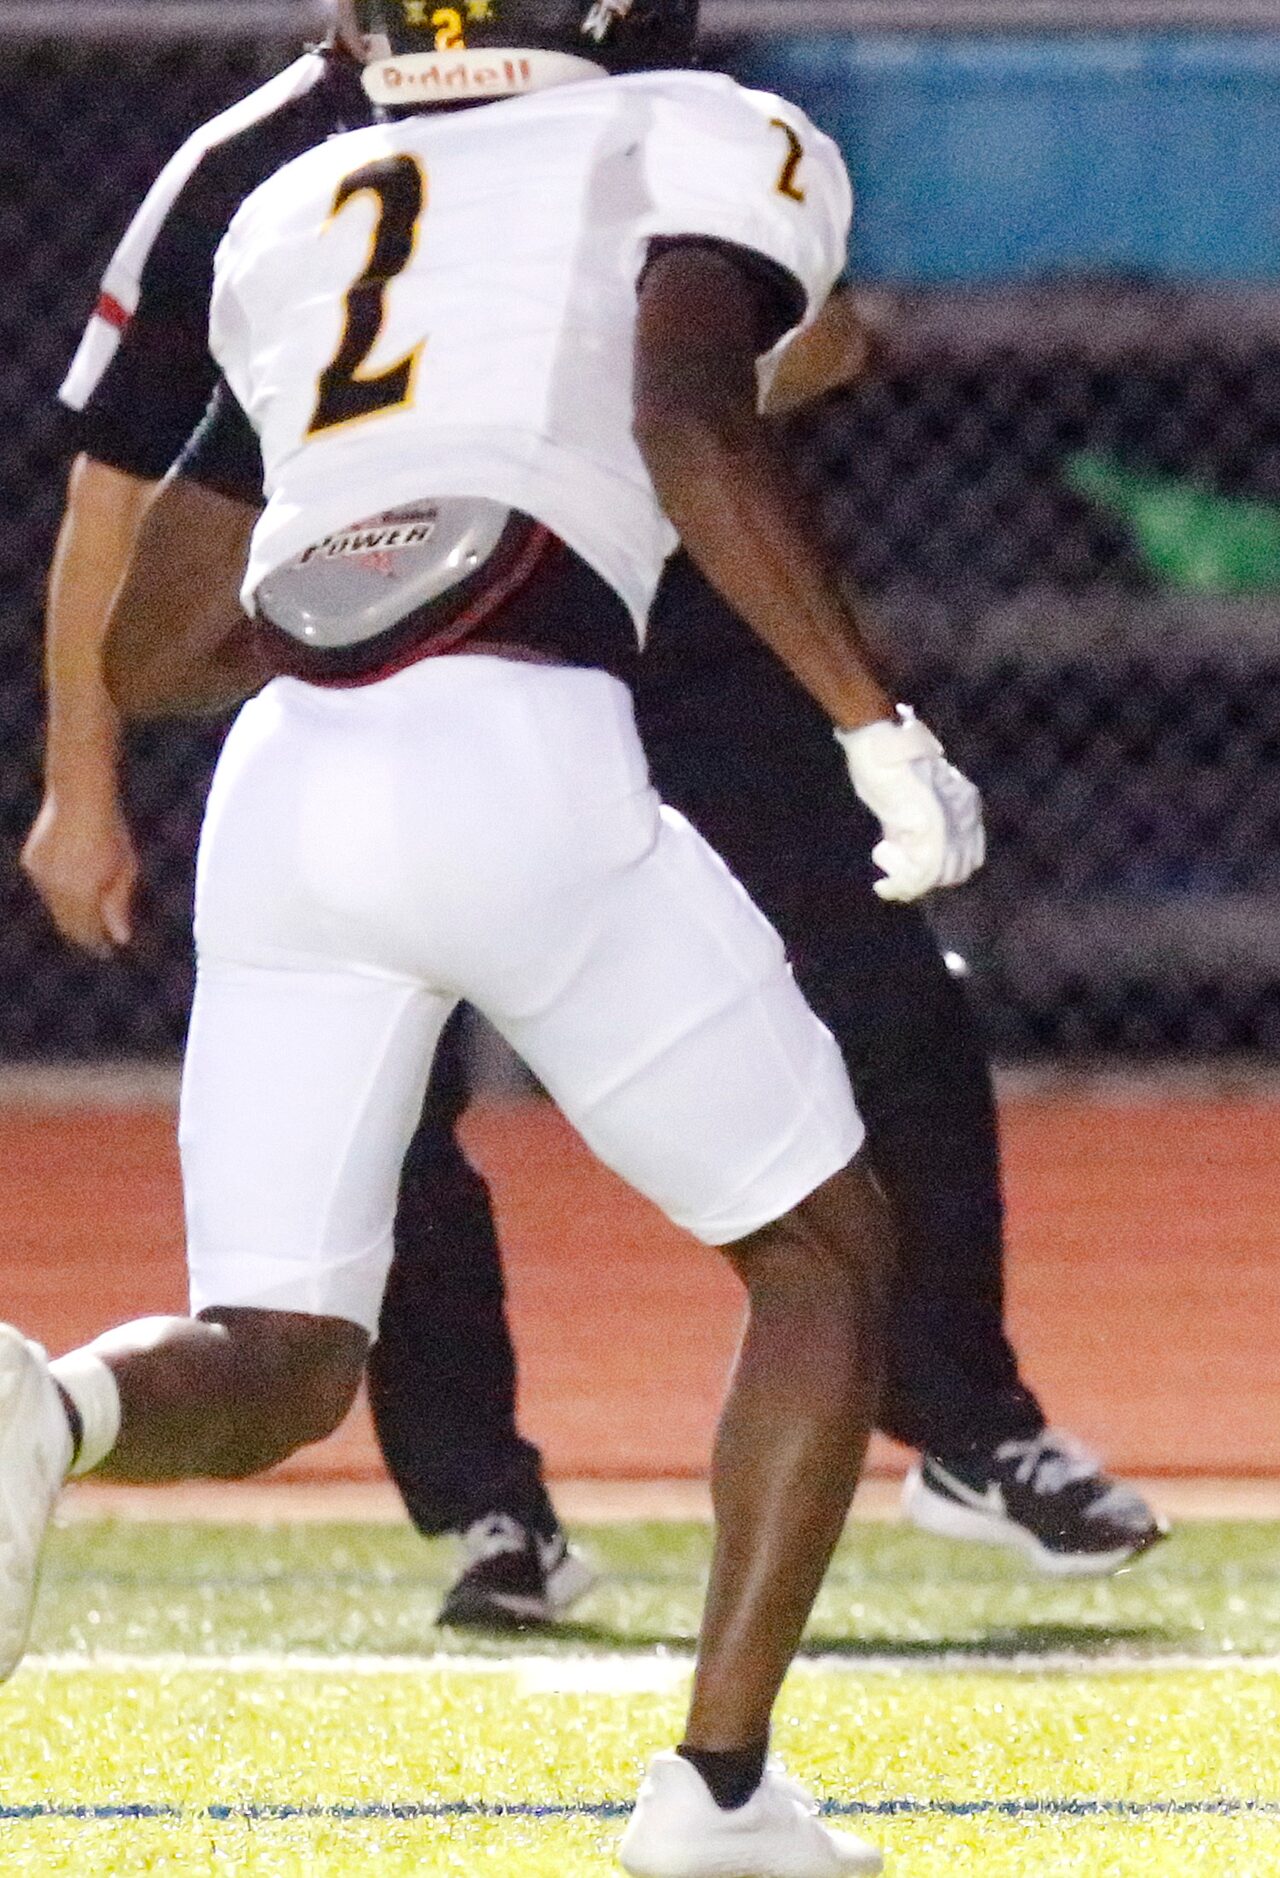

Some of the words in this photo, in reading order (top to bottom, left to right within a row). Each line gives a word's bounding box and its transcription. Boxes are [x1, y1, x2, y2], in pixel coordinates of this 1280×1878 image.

[432, 7, 466, 53] 2
[769, 117, 806, 204] 2
[302, 152, 430, 442] 2
